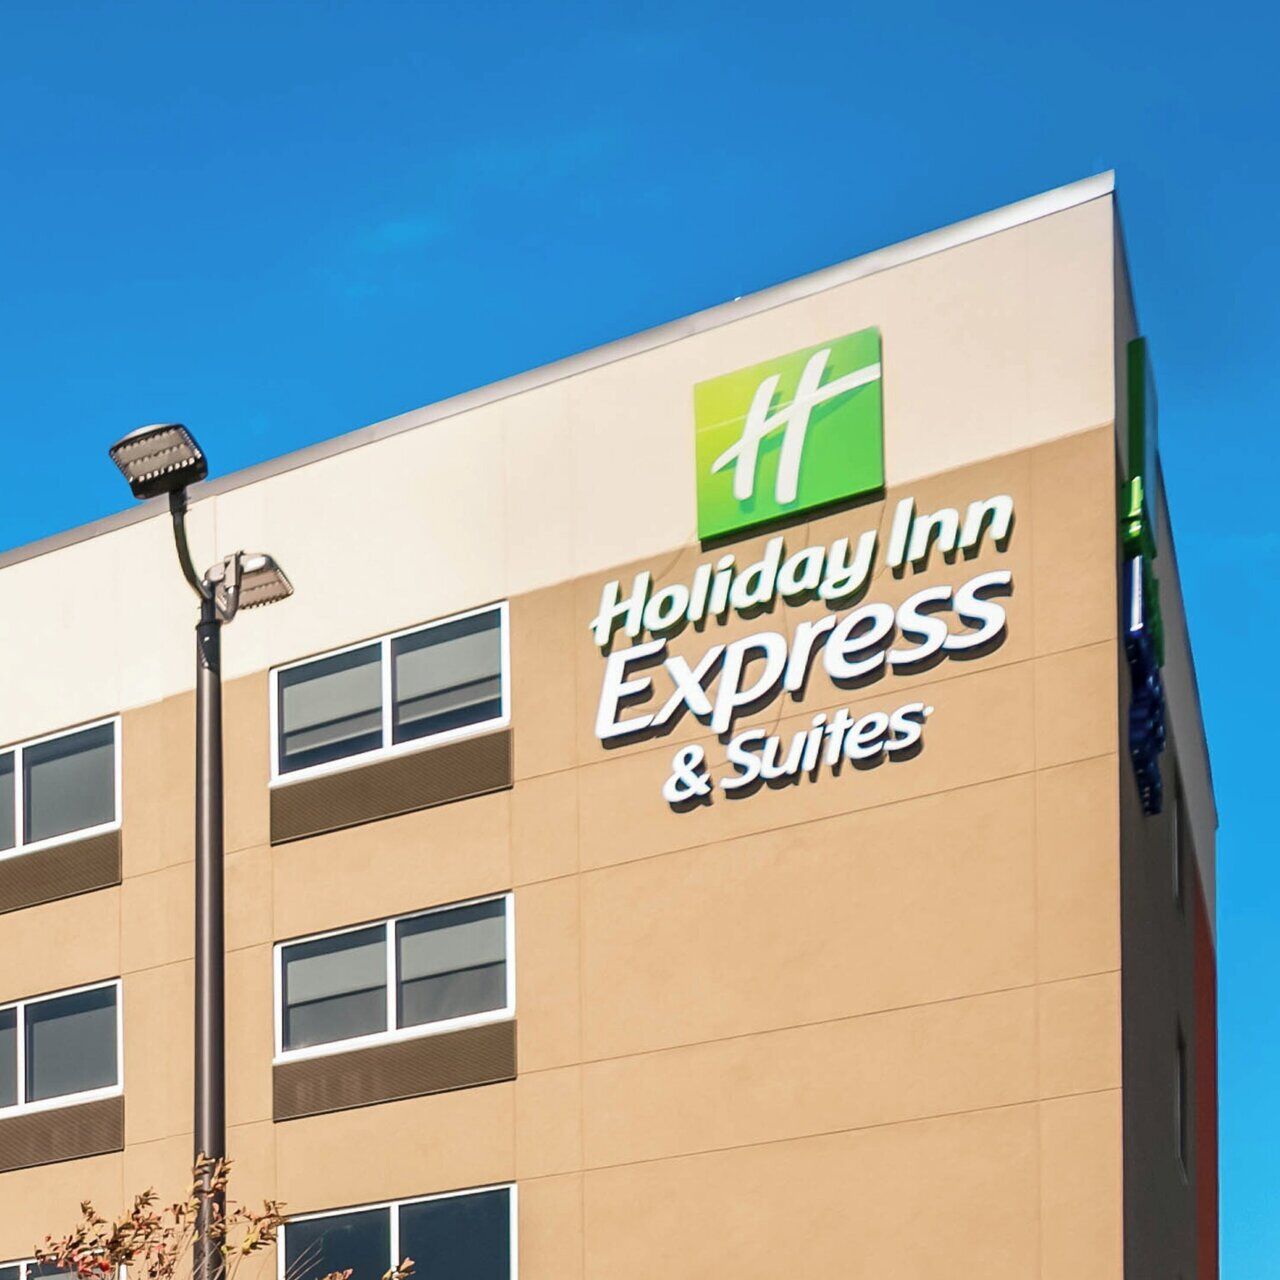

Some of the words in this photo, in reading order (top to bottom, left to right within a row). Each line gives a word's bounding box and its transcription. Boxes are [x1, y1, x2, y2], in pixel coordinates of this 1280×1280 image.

[589, 529, 879, 646] Holiday
[886, 494, 1014, 569] Inn
[595, 570, 1013, 739] Express
[662, 744, 712, 803] &
[719, 702, 927, 790] Suites
